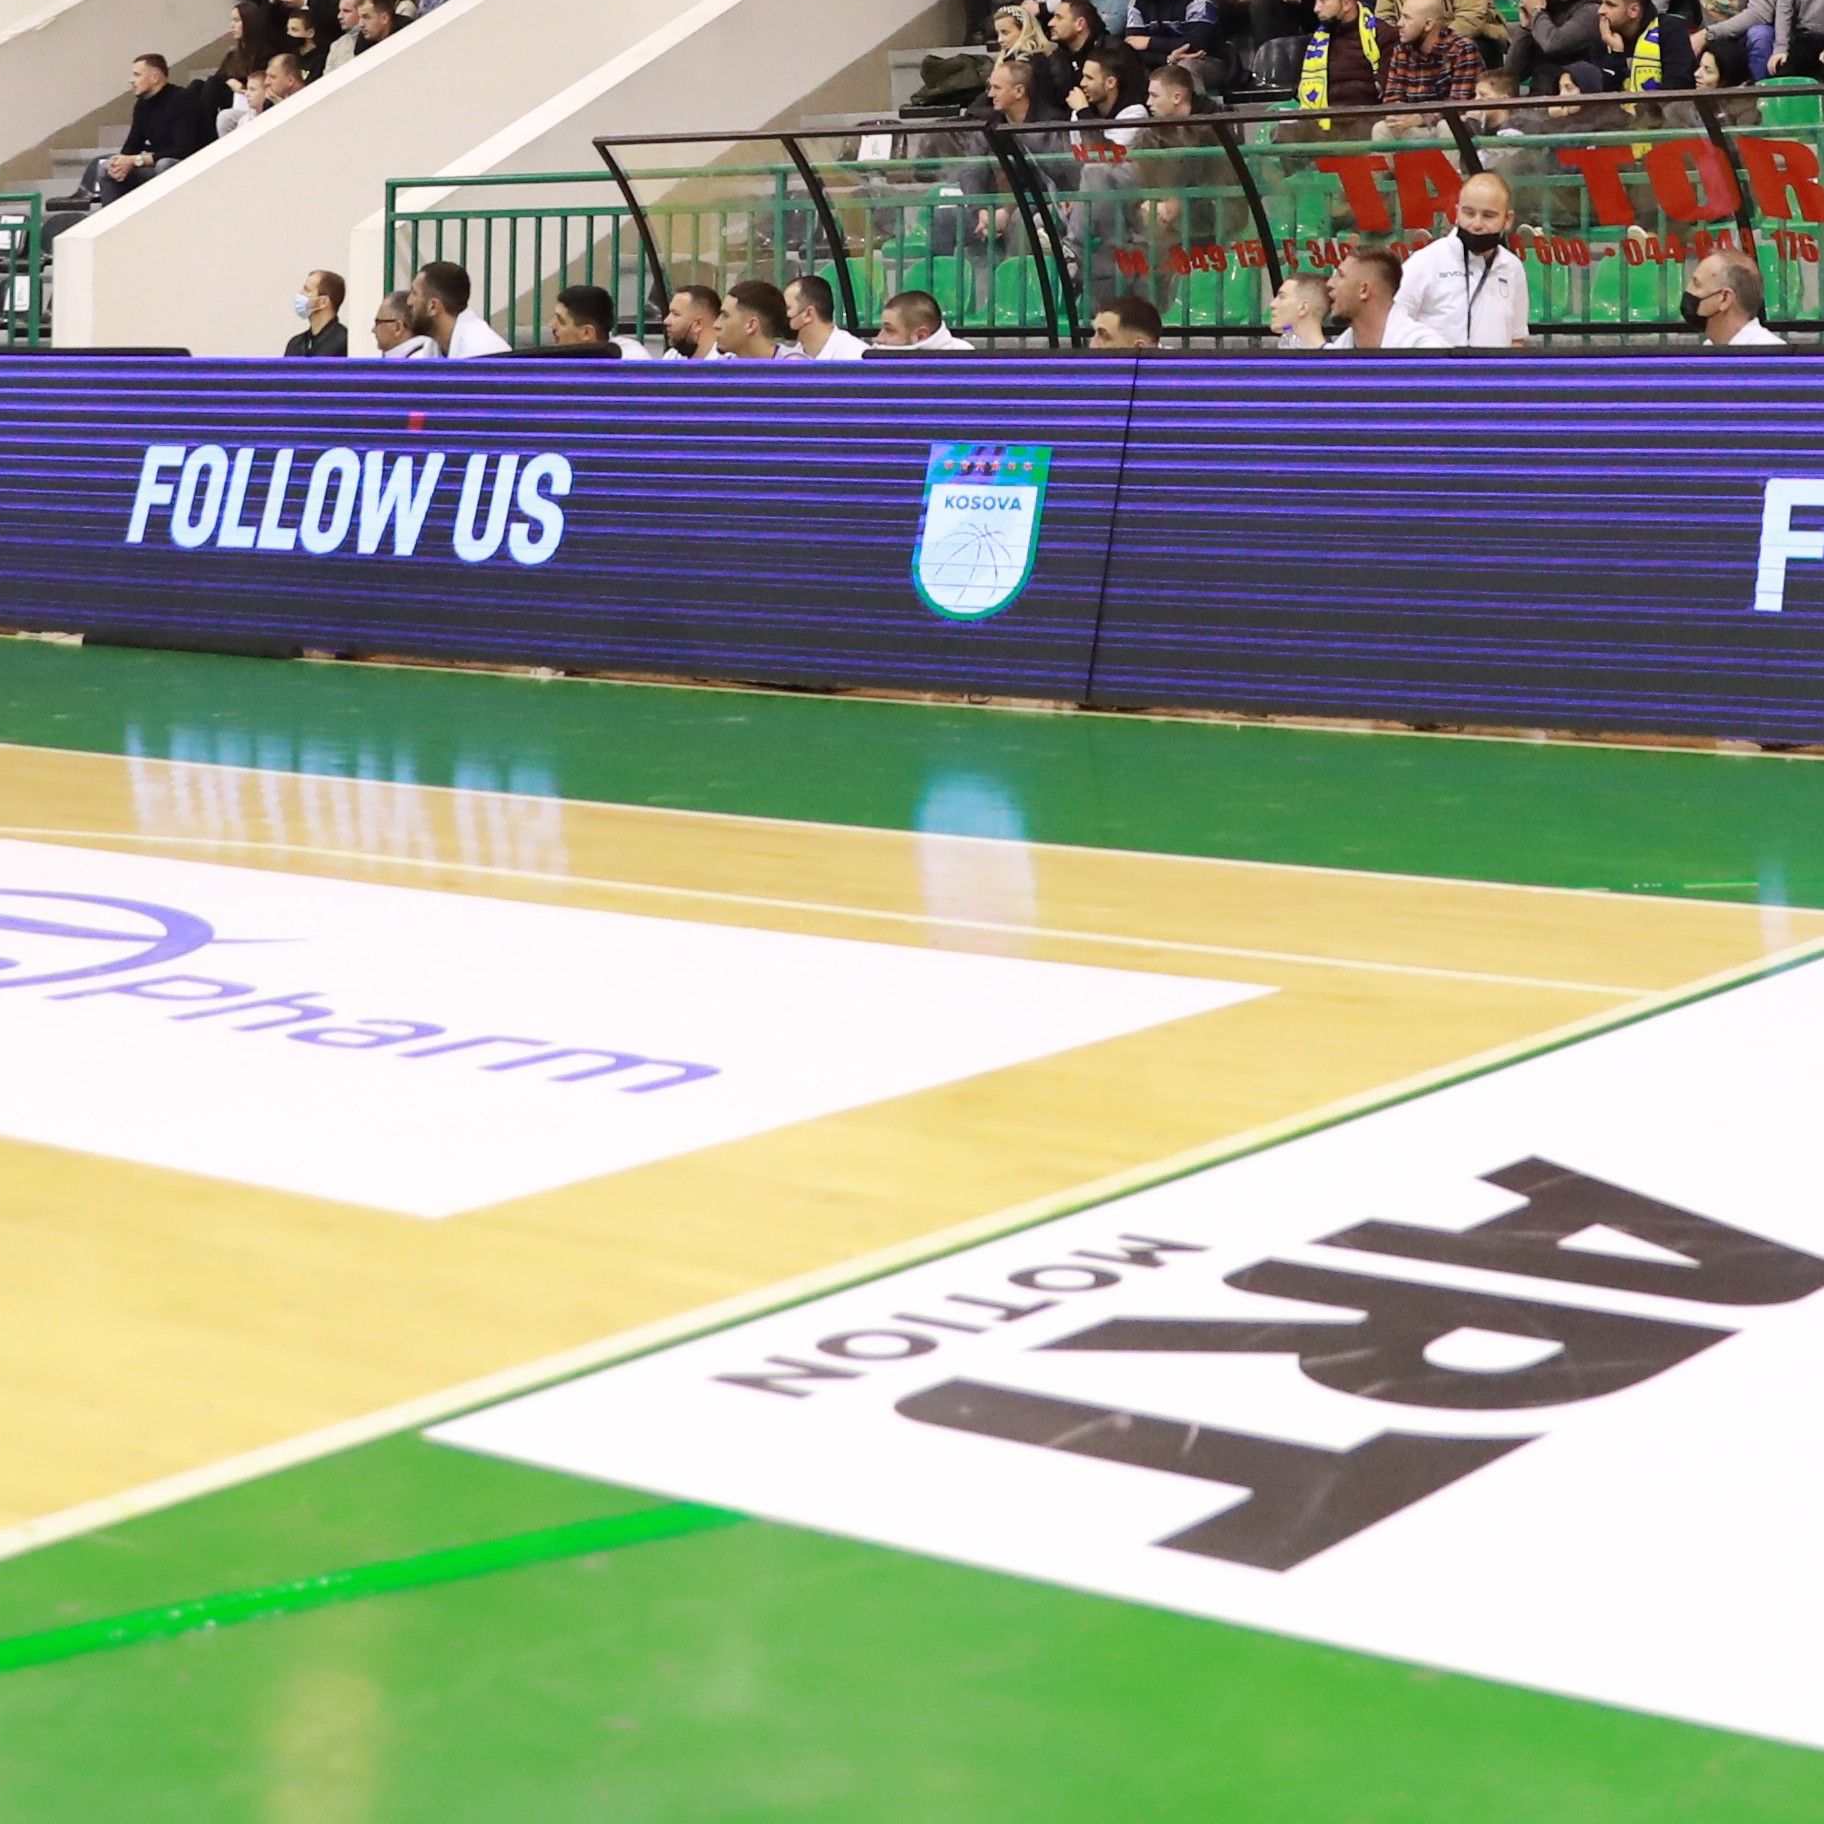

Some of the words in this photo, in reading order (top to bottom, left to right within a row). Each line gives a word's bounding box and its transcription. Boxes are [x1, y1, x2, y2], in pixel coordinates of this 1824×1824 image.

[126, 444, 445, 557] FOLLOW
[452, 452, 574, 565] US
[944, 496, 1023, 512] KOSOVA
[704, 1233, 1212, 1401] MOTION
